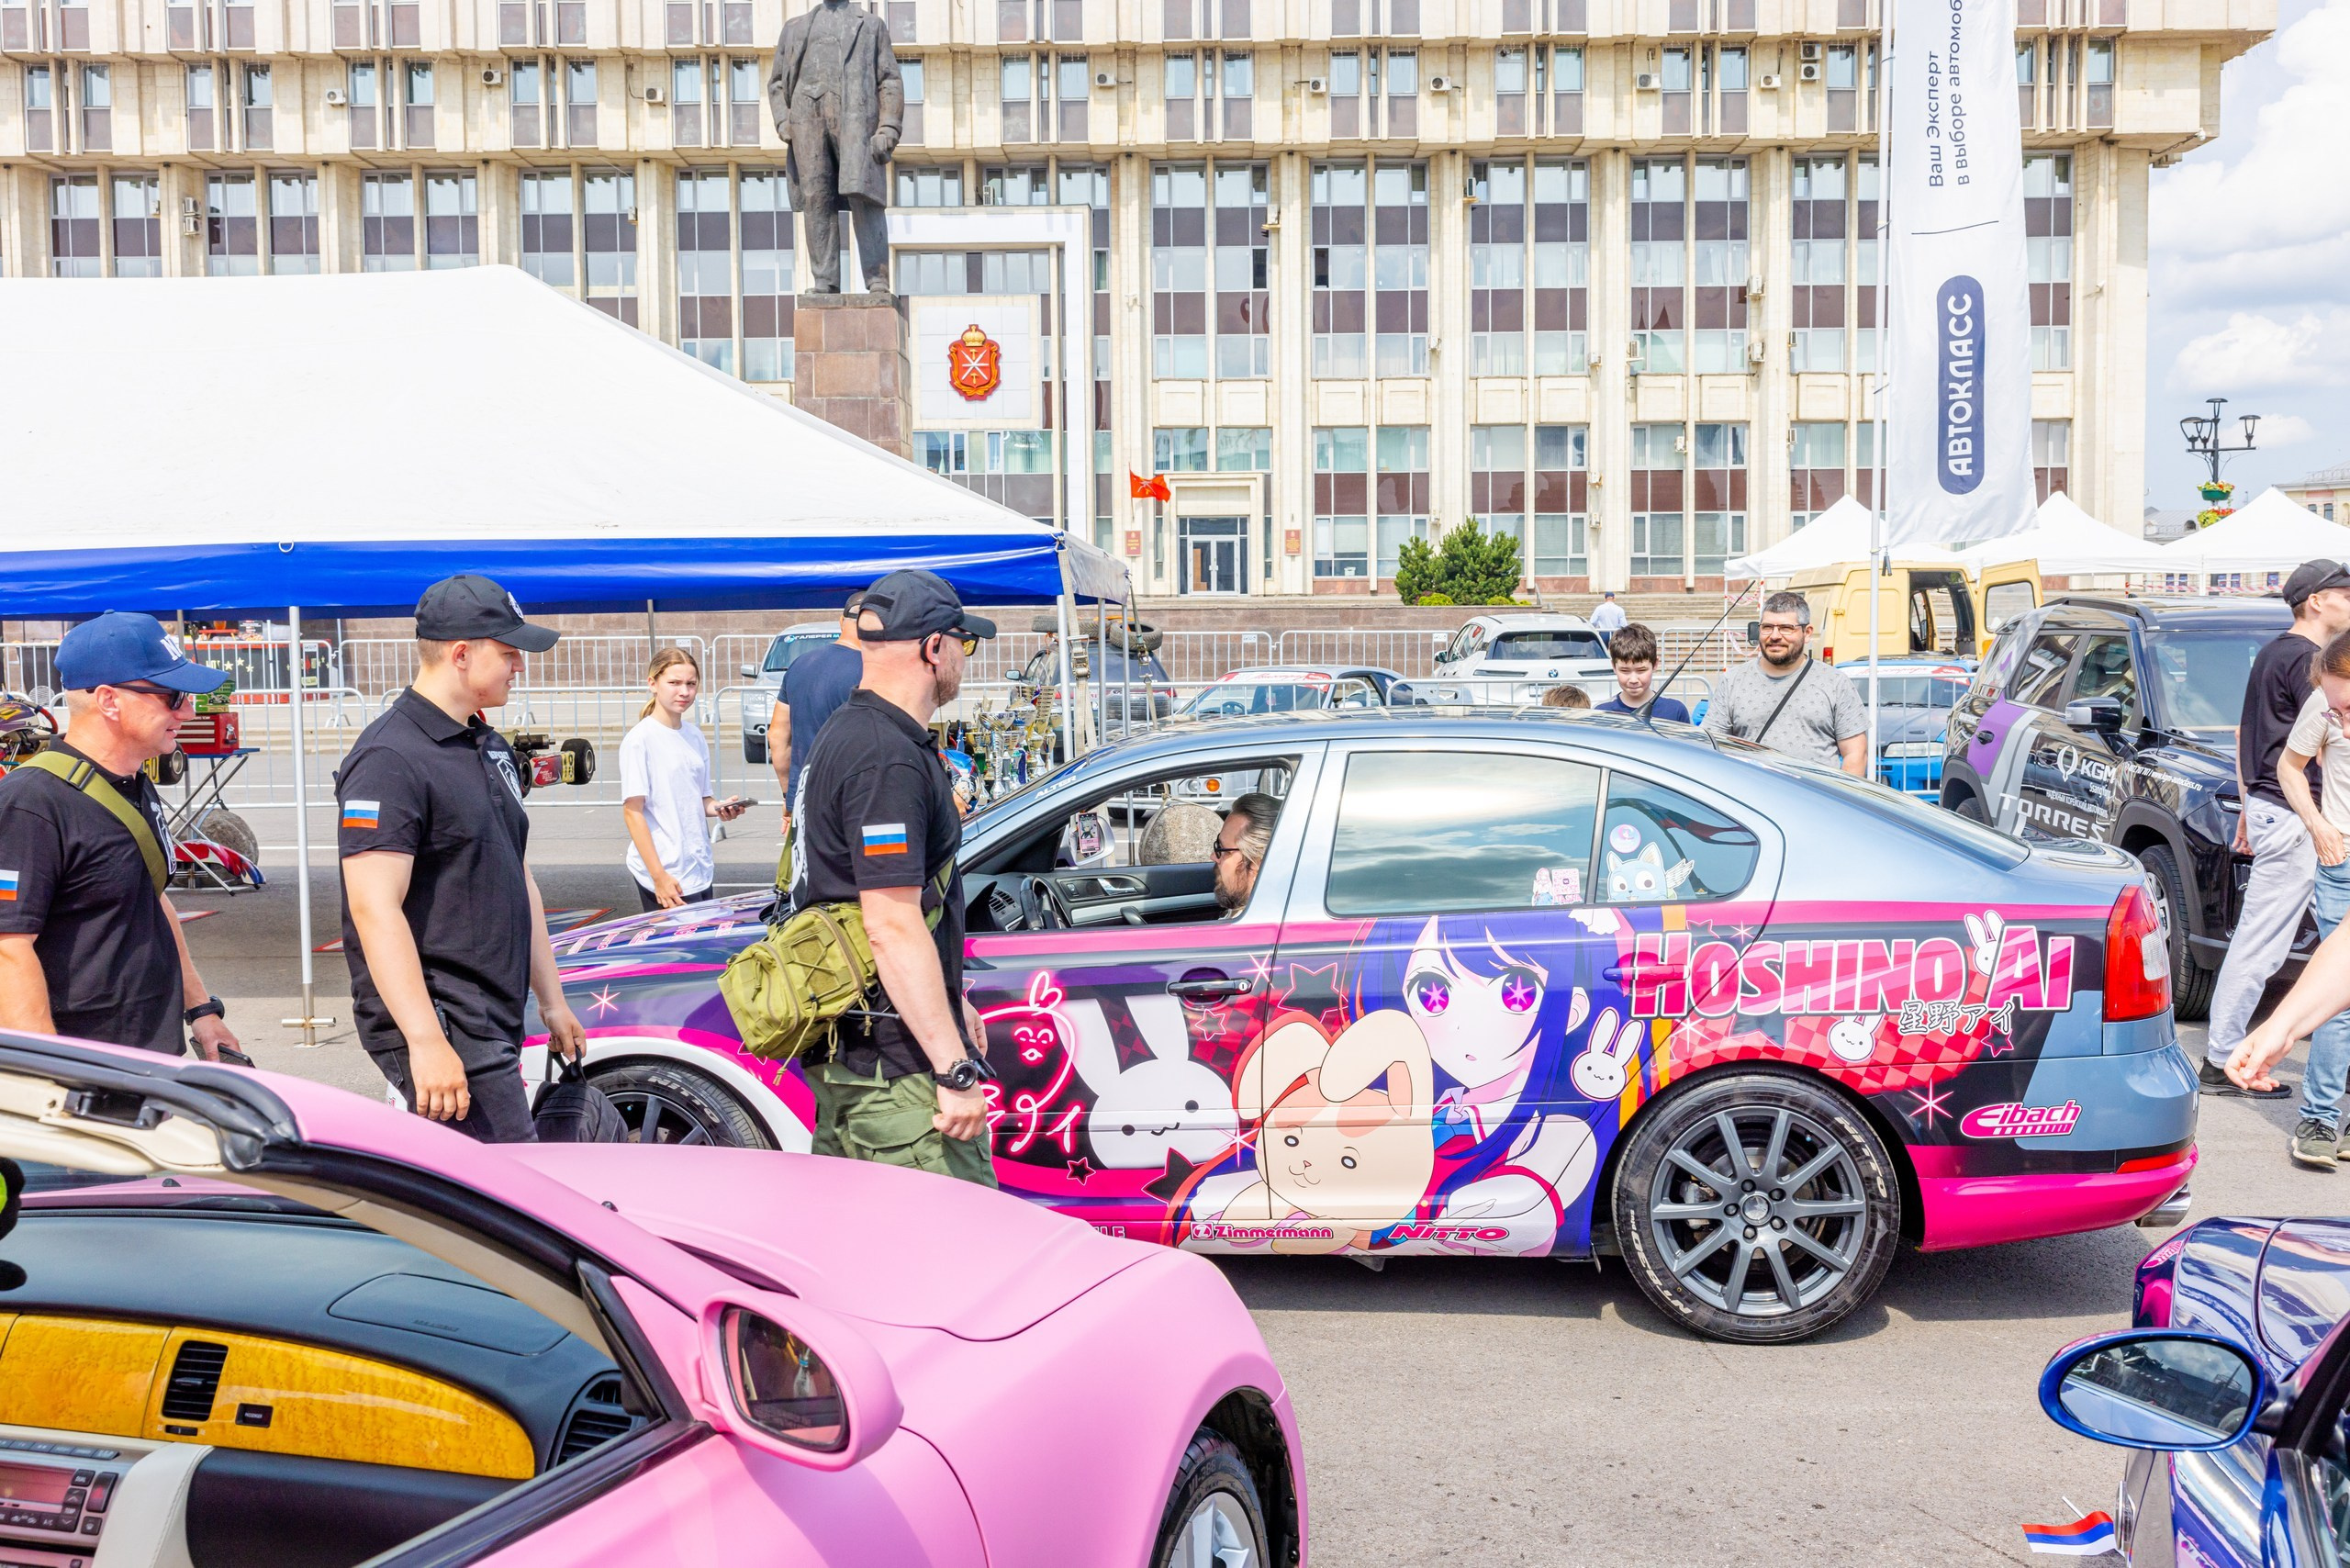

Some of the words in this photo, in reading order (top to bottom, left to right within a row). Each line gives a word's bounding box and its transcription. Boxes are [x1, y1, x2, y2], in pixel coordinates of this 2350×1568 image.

[1949, 0, 1963, 86] автомоб
[1927, 50, 1942, 139] Эксперт
[1949, 93, 1968, 169] выборе
[1929, 145, 1943, 186] Ваш
[1957, 174, 1970, 185] в
[1947, 293, 1973, 476] АВТОКЛАСС
[1035, 776, 1077, 799] ALTER
[2080, 758, 2118, 784] KGM
[1999, 793, 2107, 843] TORRES
[1631, 933, 1967, 1016] HOSHINO
[1986, 925, 2075, 1011] AI
[1898, 1000, 2014, 1036] 星野アイ
[648, 1075, 721, 1124] NITTO
[1962, 1101, 2082, 1137] Eibach
[1834, 1116, 1887, 1198] NITTO
[1214, 1225, 1333, 1239] Zimmermann
[1388, 1224, 1509, 1240] NITTO
